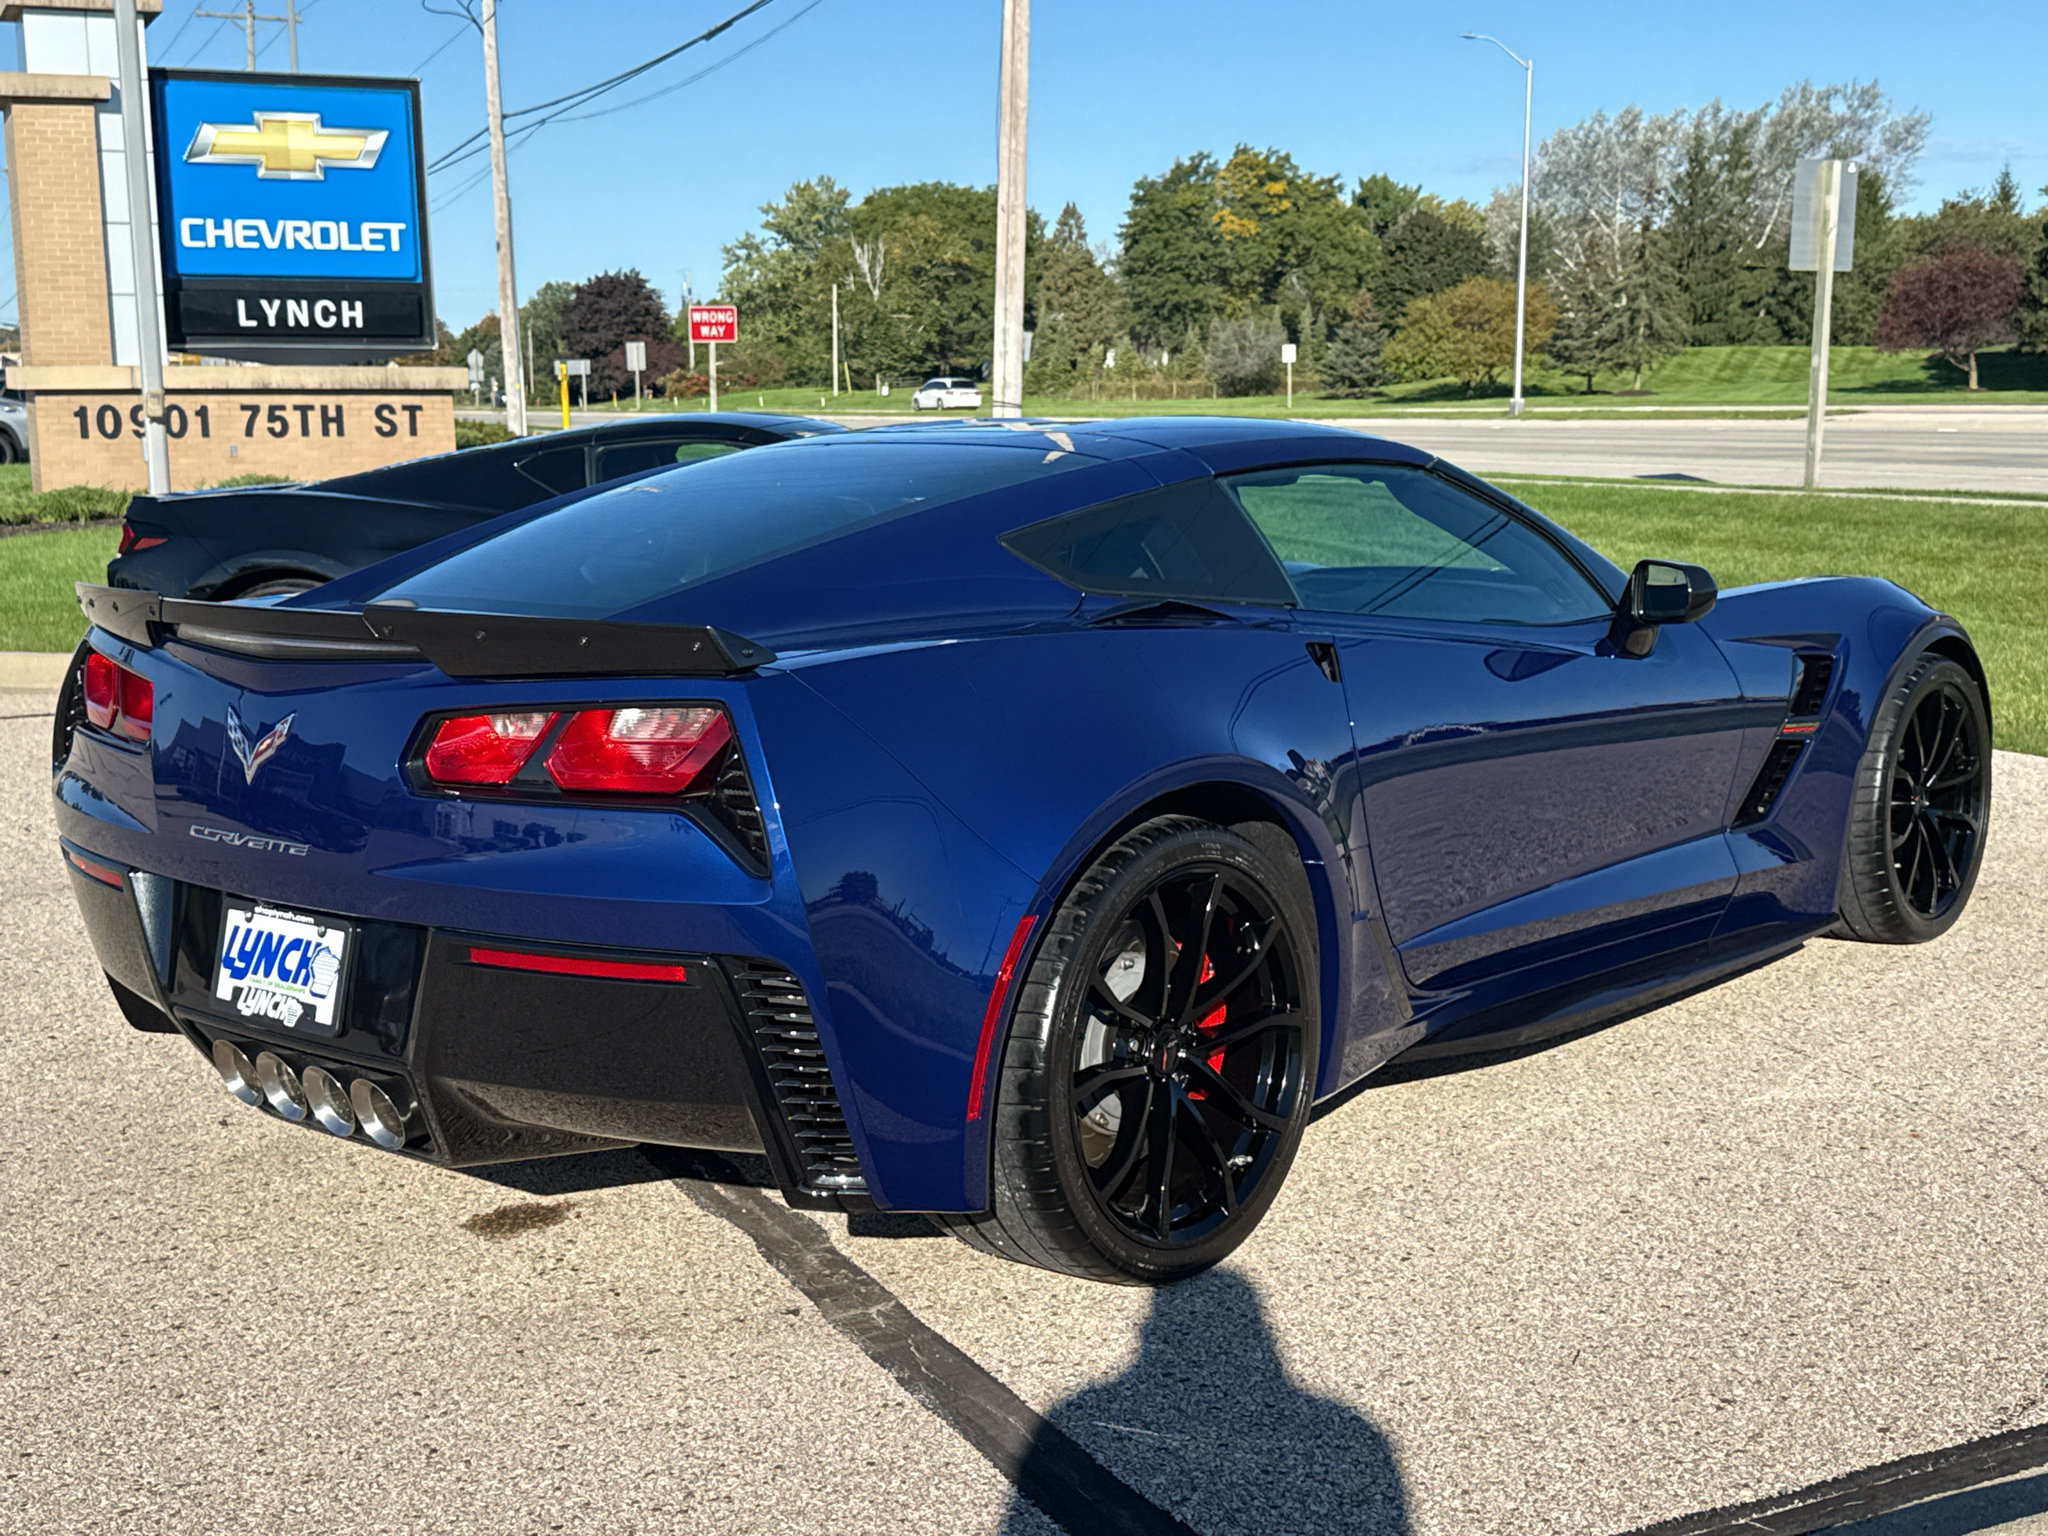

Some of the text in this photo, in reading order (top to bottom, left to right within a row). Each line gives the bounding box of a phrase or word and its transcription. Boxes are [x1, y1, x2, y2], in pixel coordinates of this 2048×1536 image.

[180, 218, 406, 252] CHEVROLET
[236, 298, 364, 329] LYNCH
[692, 311, 733, 323] WRONG
[700, 325, 726, 338] WAY
[240, 404, 345, 438] 75TH
[374, 404, 423, 437] ST
[190, 825, 312, 856] CORVETTE
[222, 925, 323, 987] LYNCH
[237, 986, 294, 1020] LYNCH
